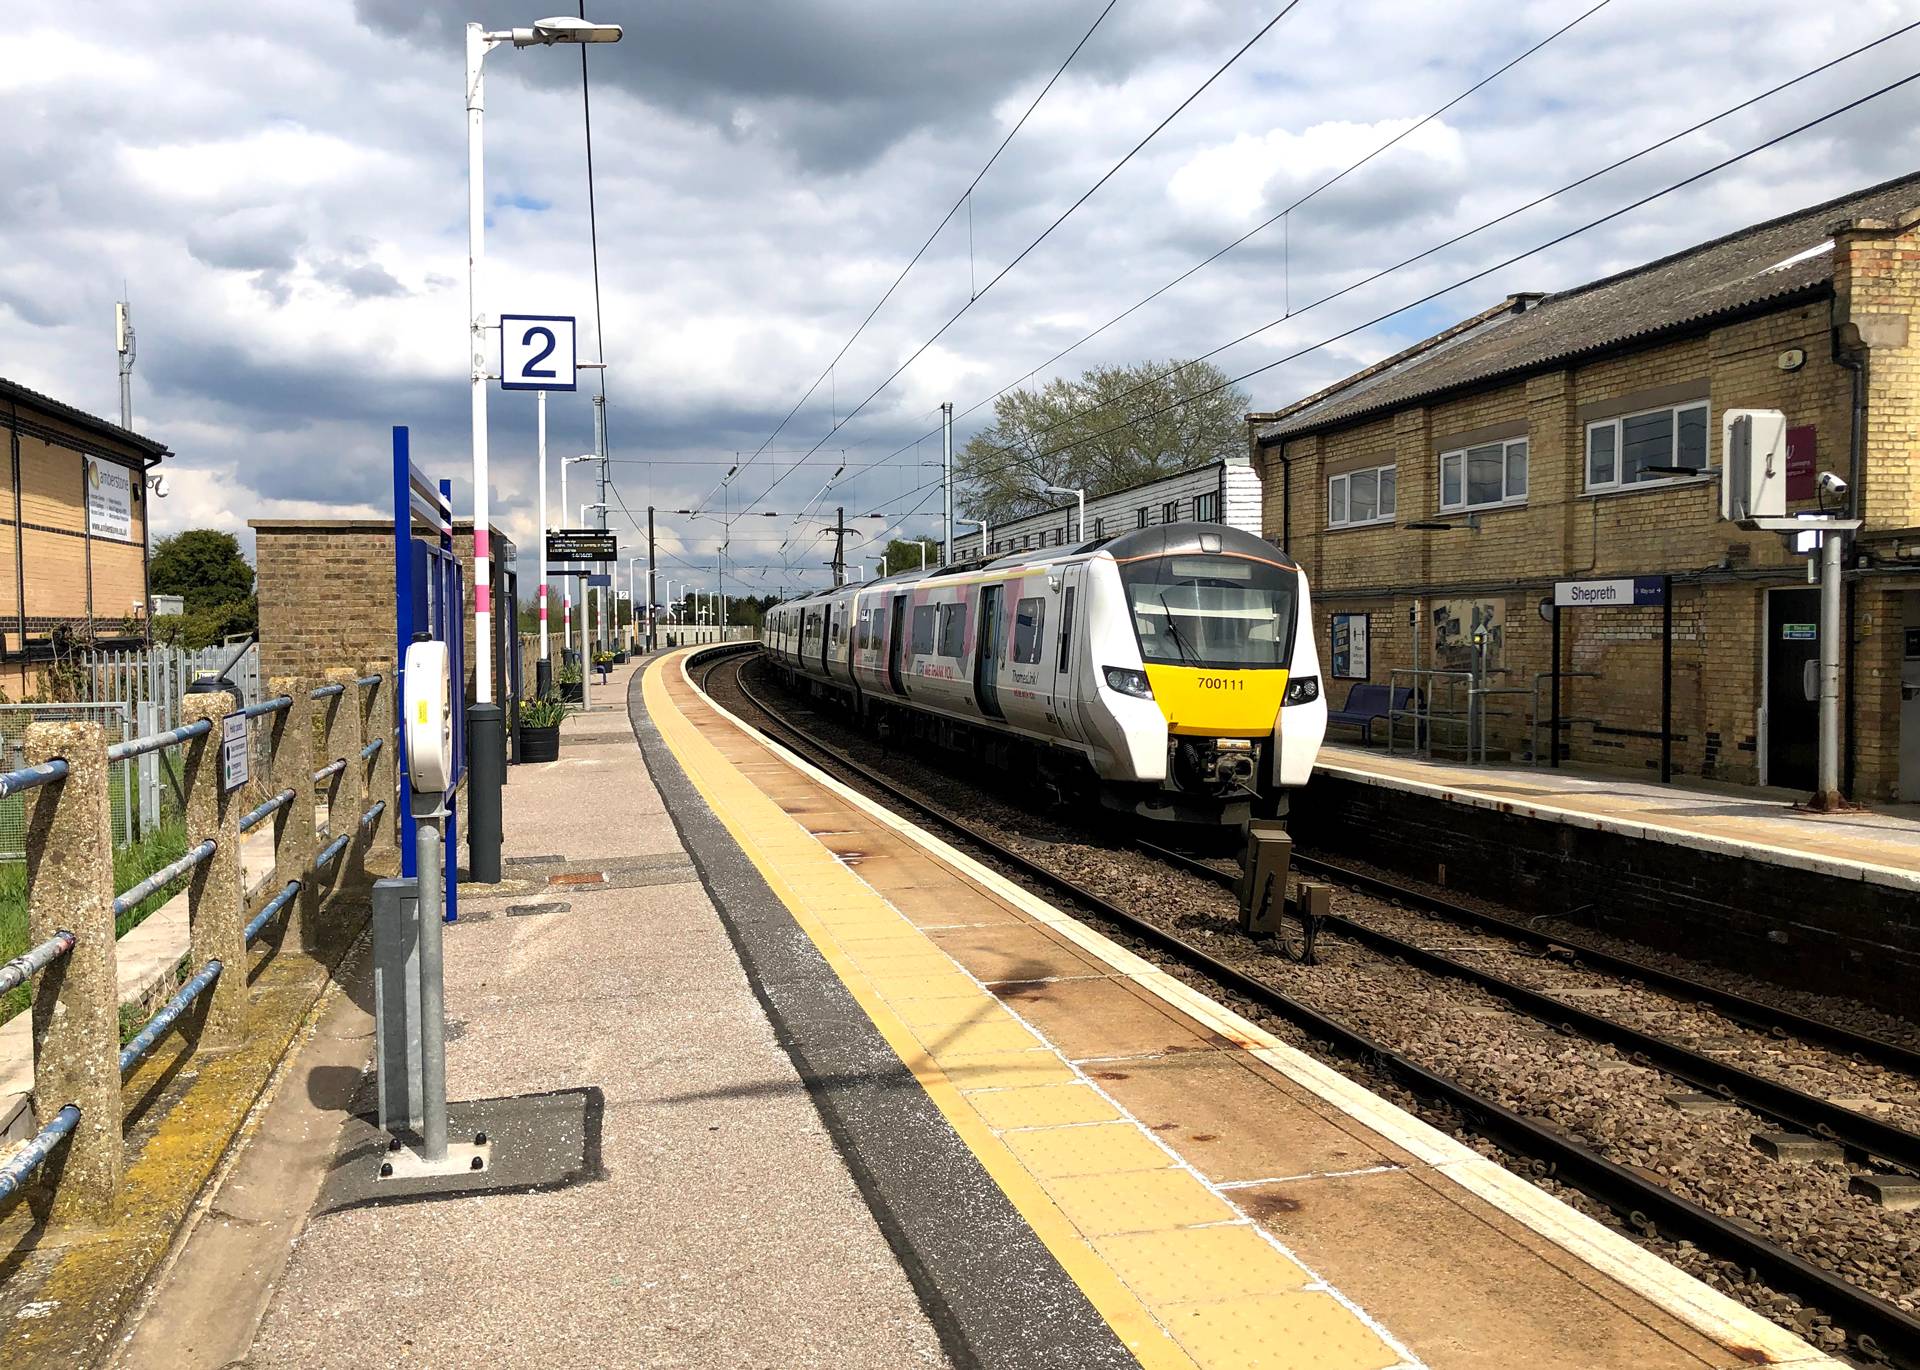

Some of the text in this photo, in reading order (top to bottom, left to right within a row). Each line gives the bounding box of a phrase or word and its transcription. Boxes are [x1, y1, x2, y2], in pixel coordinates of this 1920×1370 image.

[522, 326, 557, 378] 2
[1571, 585, 1617, 603] Shepreth
[1198, 677, 1243, 690] 700111
